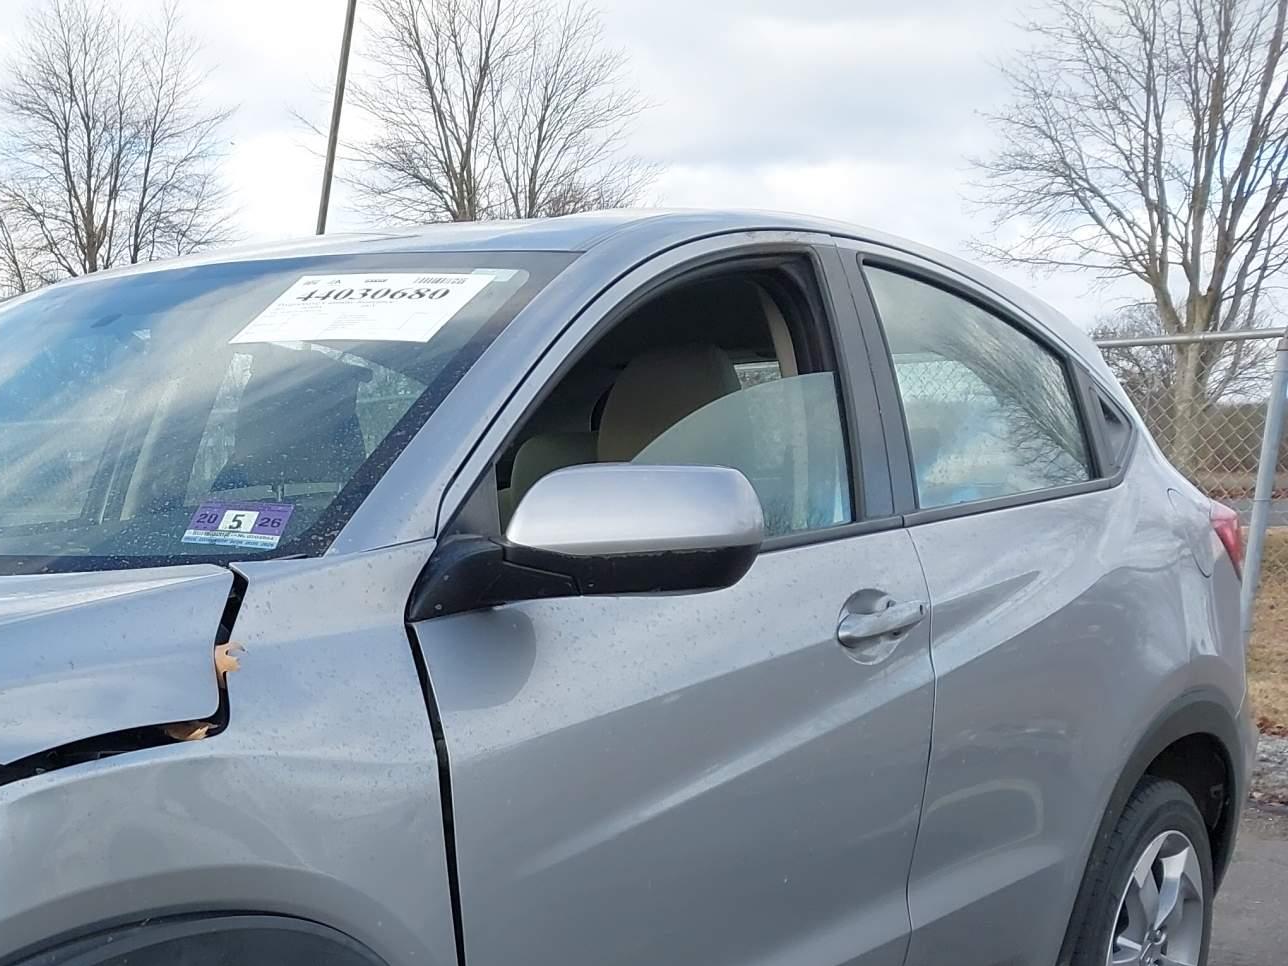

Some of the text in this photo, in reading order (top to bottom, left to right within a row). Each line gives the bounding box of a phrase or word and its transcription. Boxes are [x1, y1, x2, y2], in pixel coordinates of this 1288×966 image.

[296, 288, 450, 301] 44030680
[196, 513, 282, 530] 20 5 26
